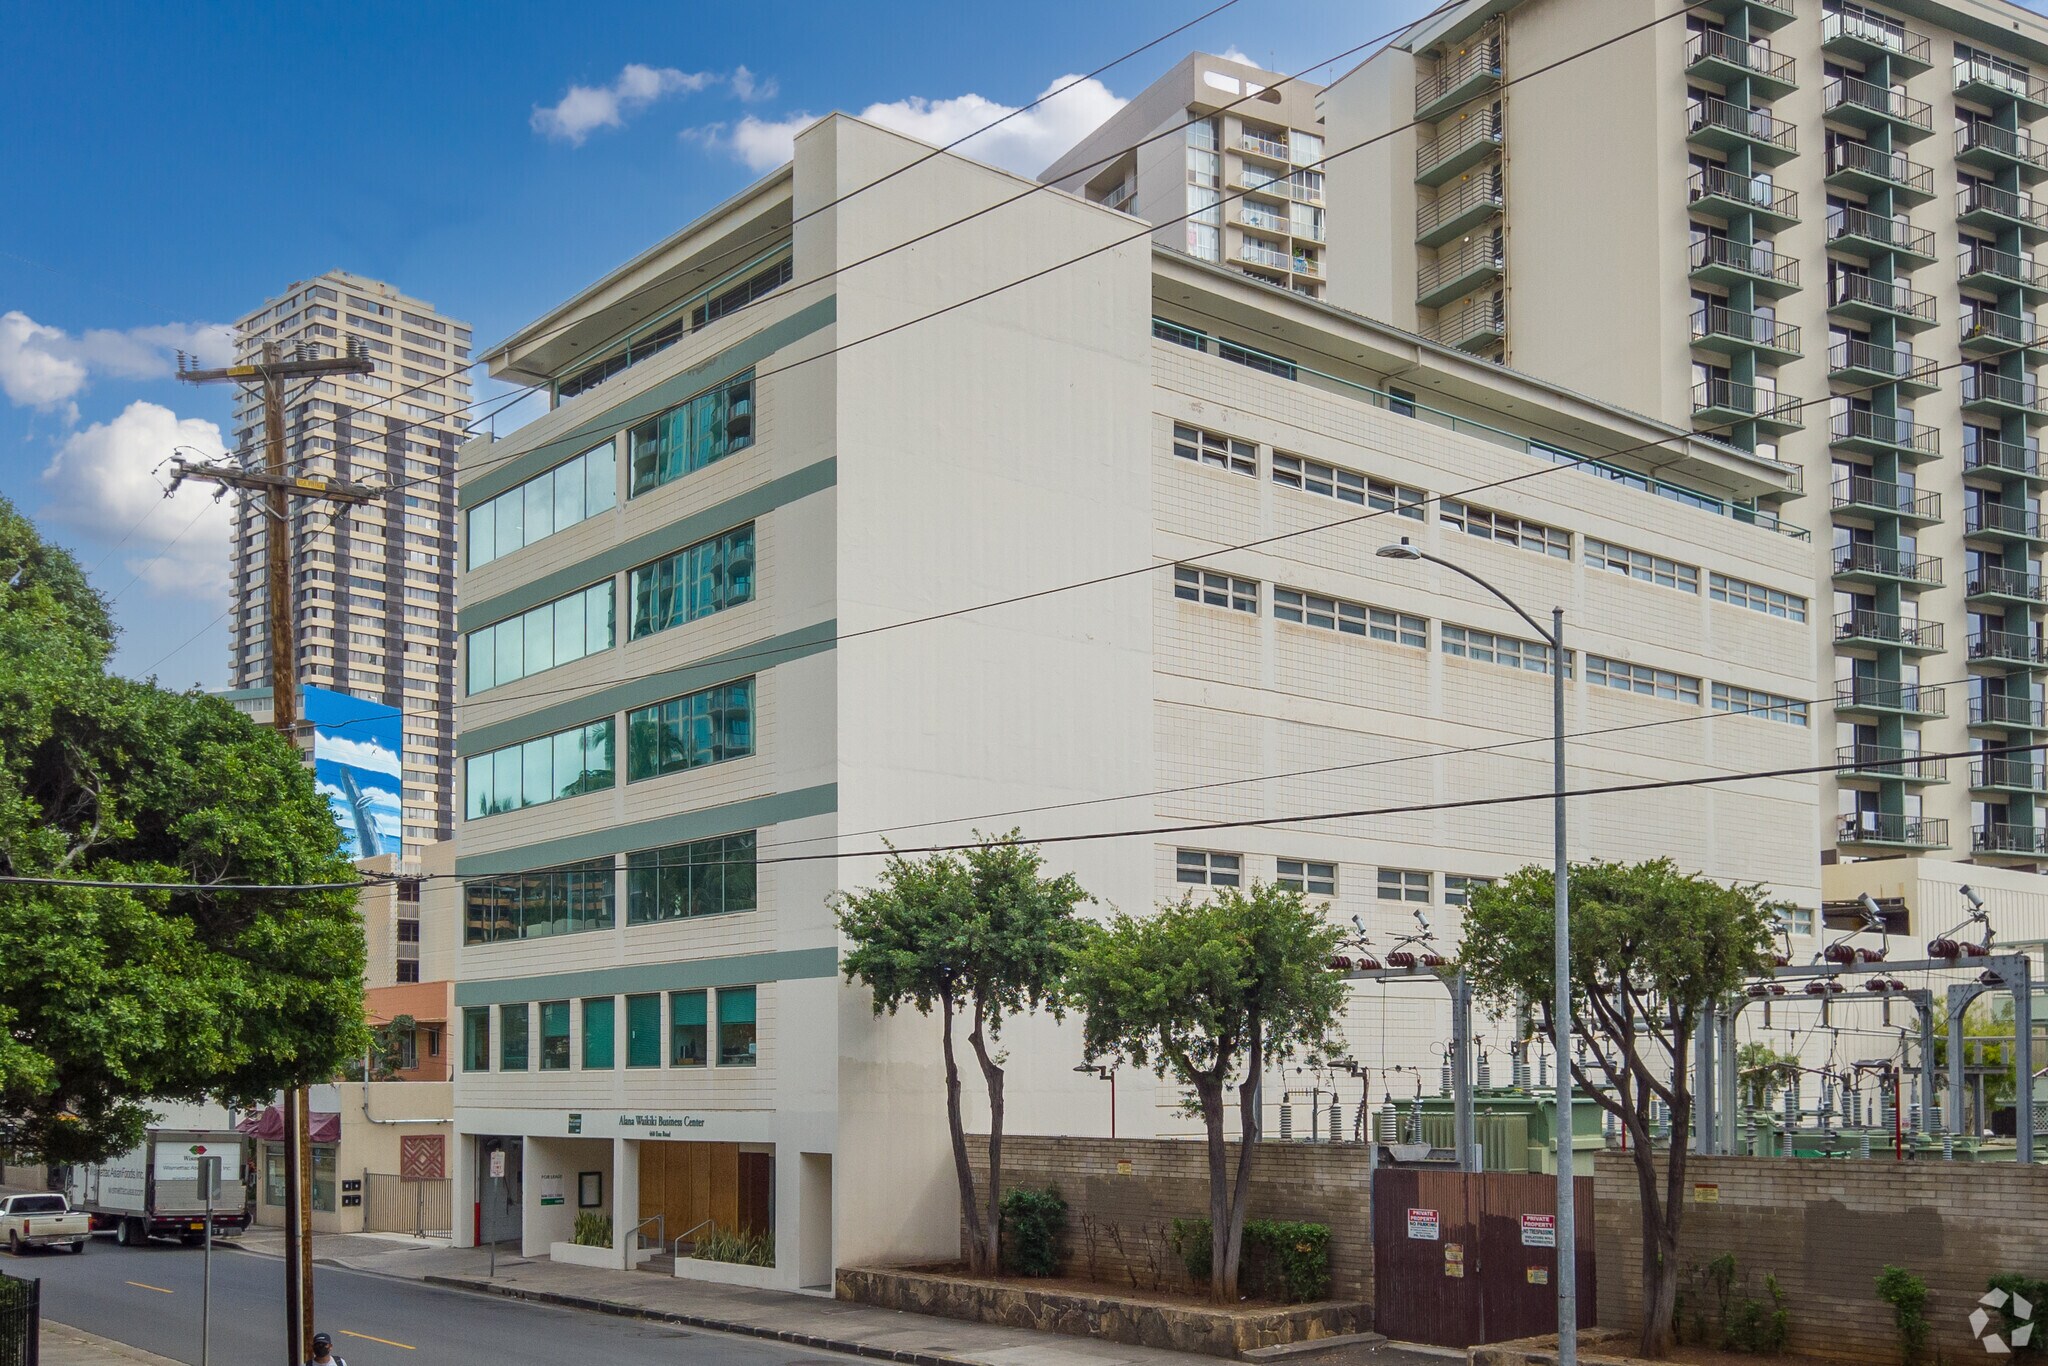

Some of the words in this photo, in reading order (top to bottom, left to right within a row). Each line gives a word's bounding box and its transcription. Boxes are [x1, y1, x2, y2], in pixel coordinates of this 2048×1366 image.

[619, 1115, 635, 1126] Alana
[635, 1115, 657, 1126] Waikiki
[658, 1116, 682, 1127] Business
[683, 1116, 705, 1127] Center
